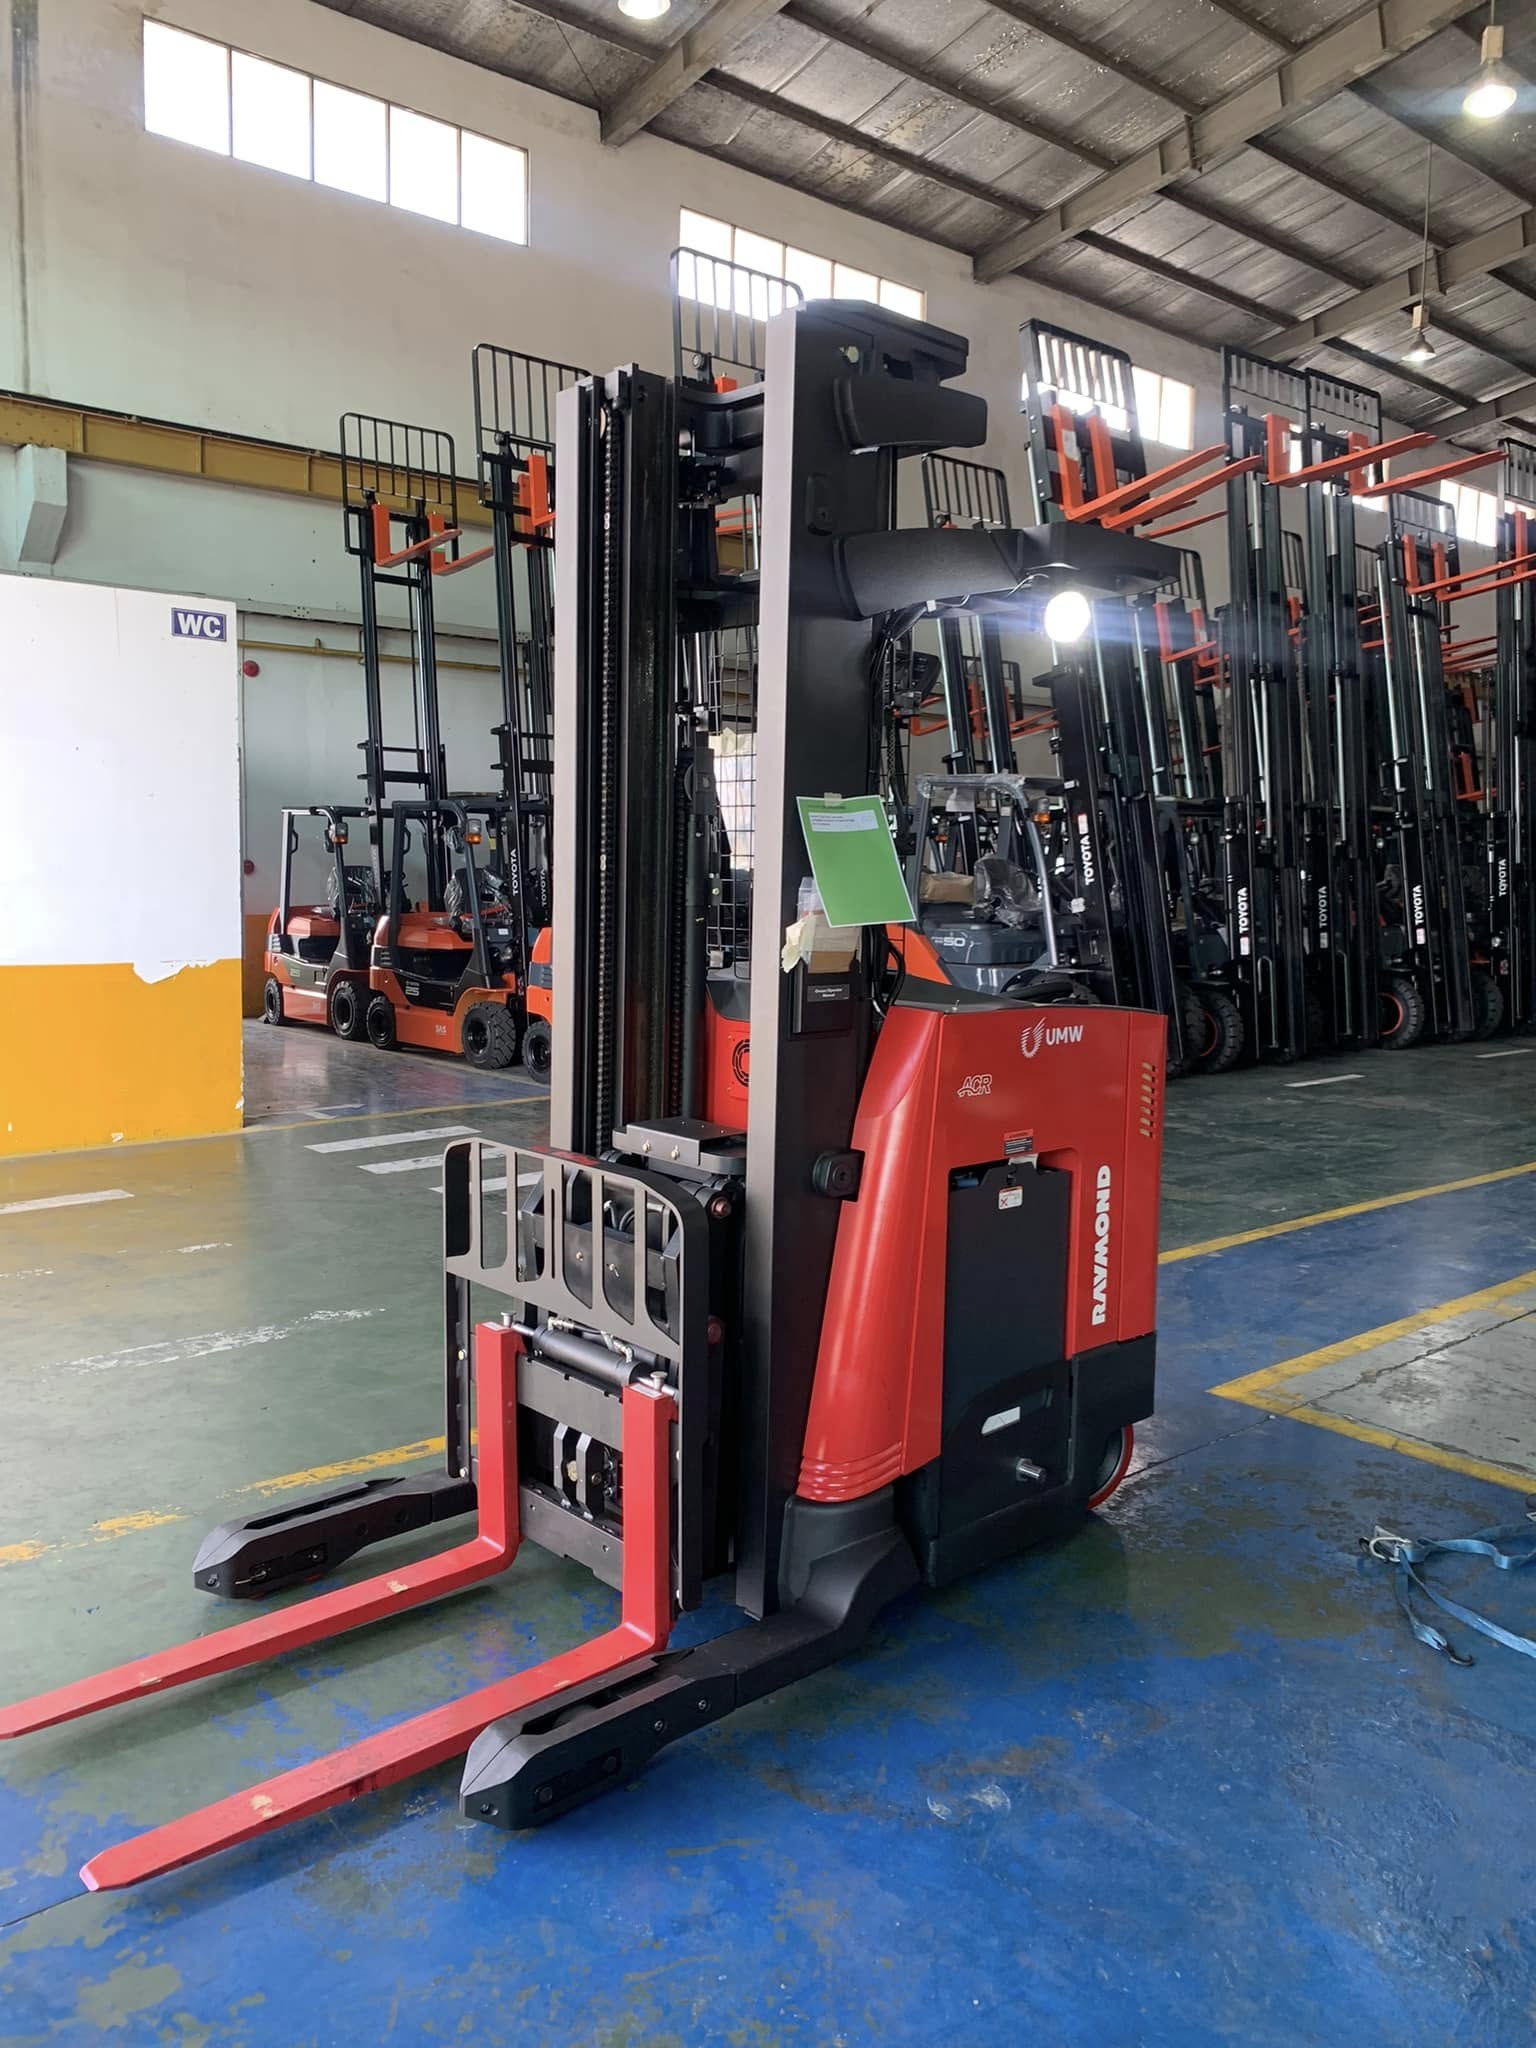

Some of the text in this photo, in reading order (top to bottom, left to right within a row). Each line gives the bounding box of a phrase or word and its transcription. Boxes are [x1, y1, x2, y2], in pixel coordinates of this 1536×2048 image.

[177, 612, 221, 638] WC
[510, 848, 520, 897] TOYOTA
[1080, 834, 1095, 886] TOYOTA
[1498, 859, 1508, 897] TOYOTA
[1237, 887, 1250, 934] TOYOTA
[1318, 886, 1328, 928] TOYOTA
[1412, 885, 1425, 926] TOYOTA
[1046, 1025, 1083, 1045] UMW
[957, 1073, 993, 1097] ACR
[1092, 1165, 1111, 1326] RAYMOND
